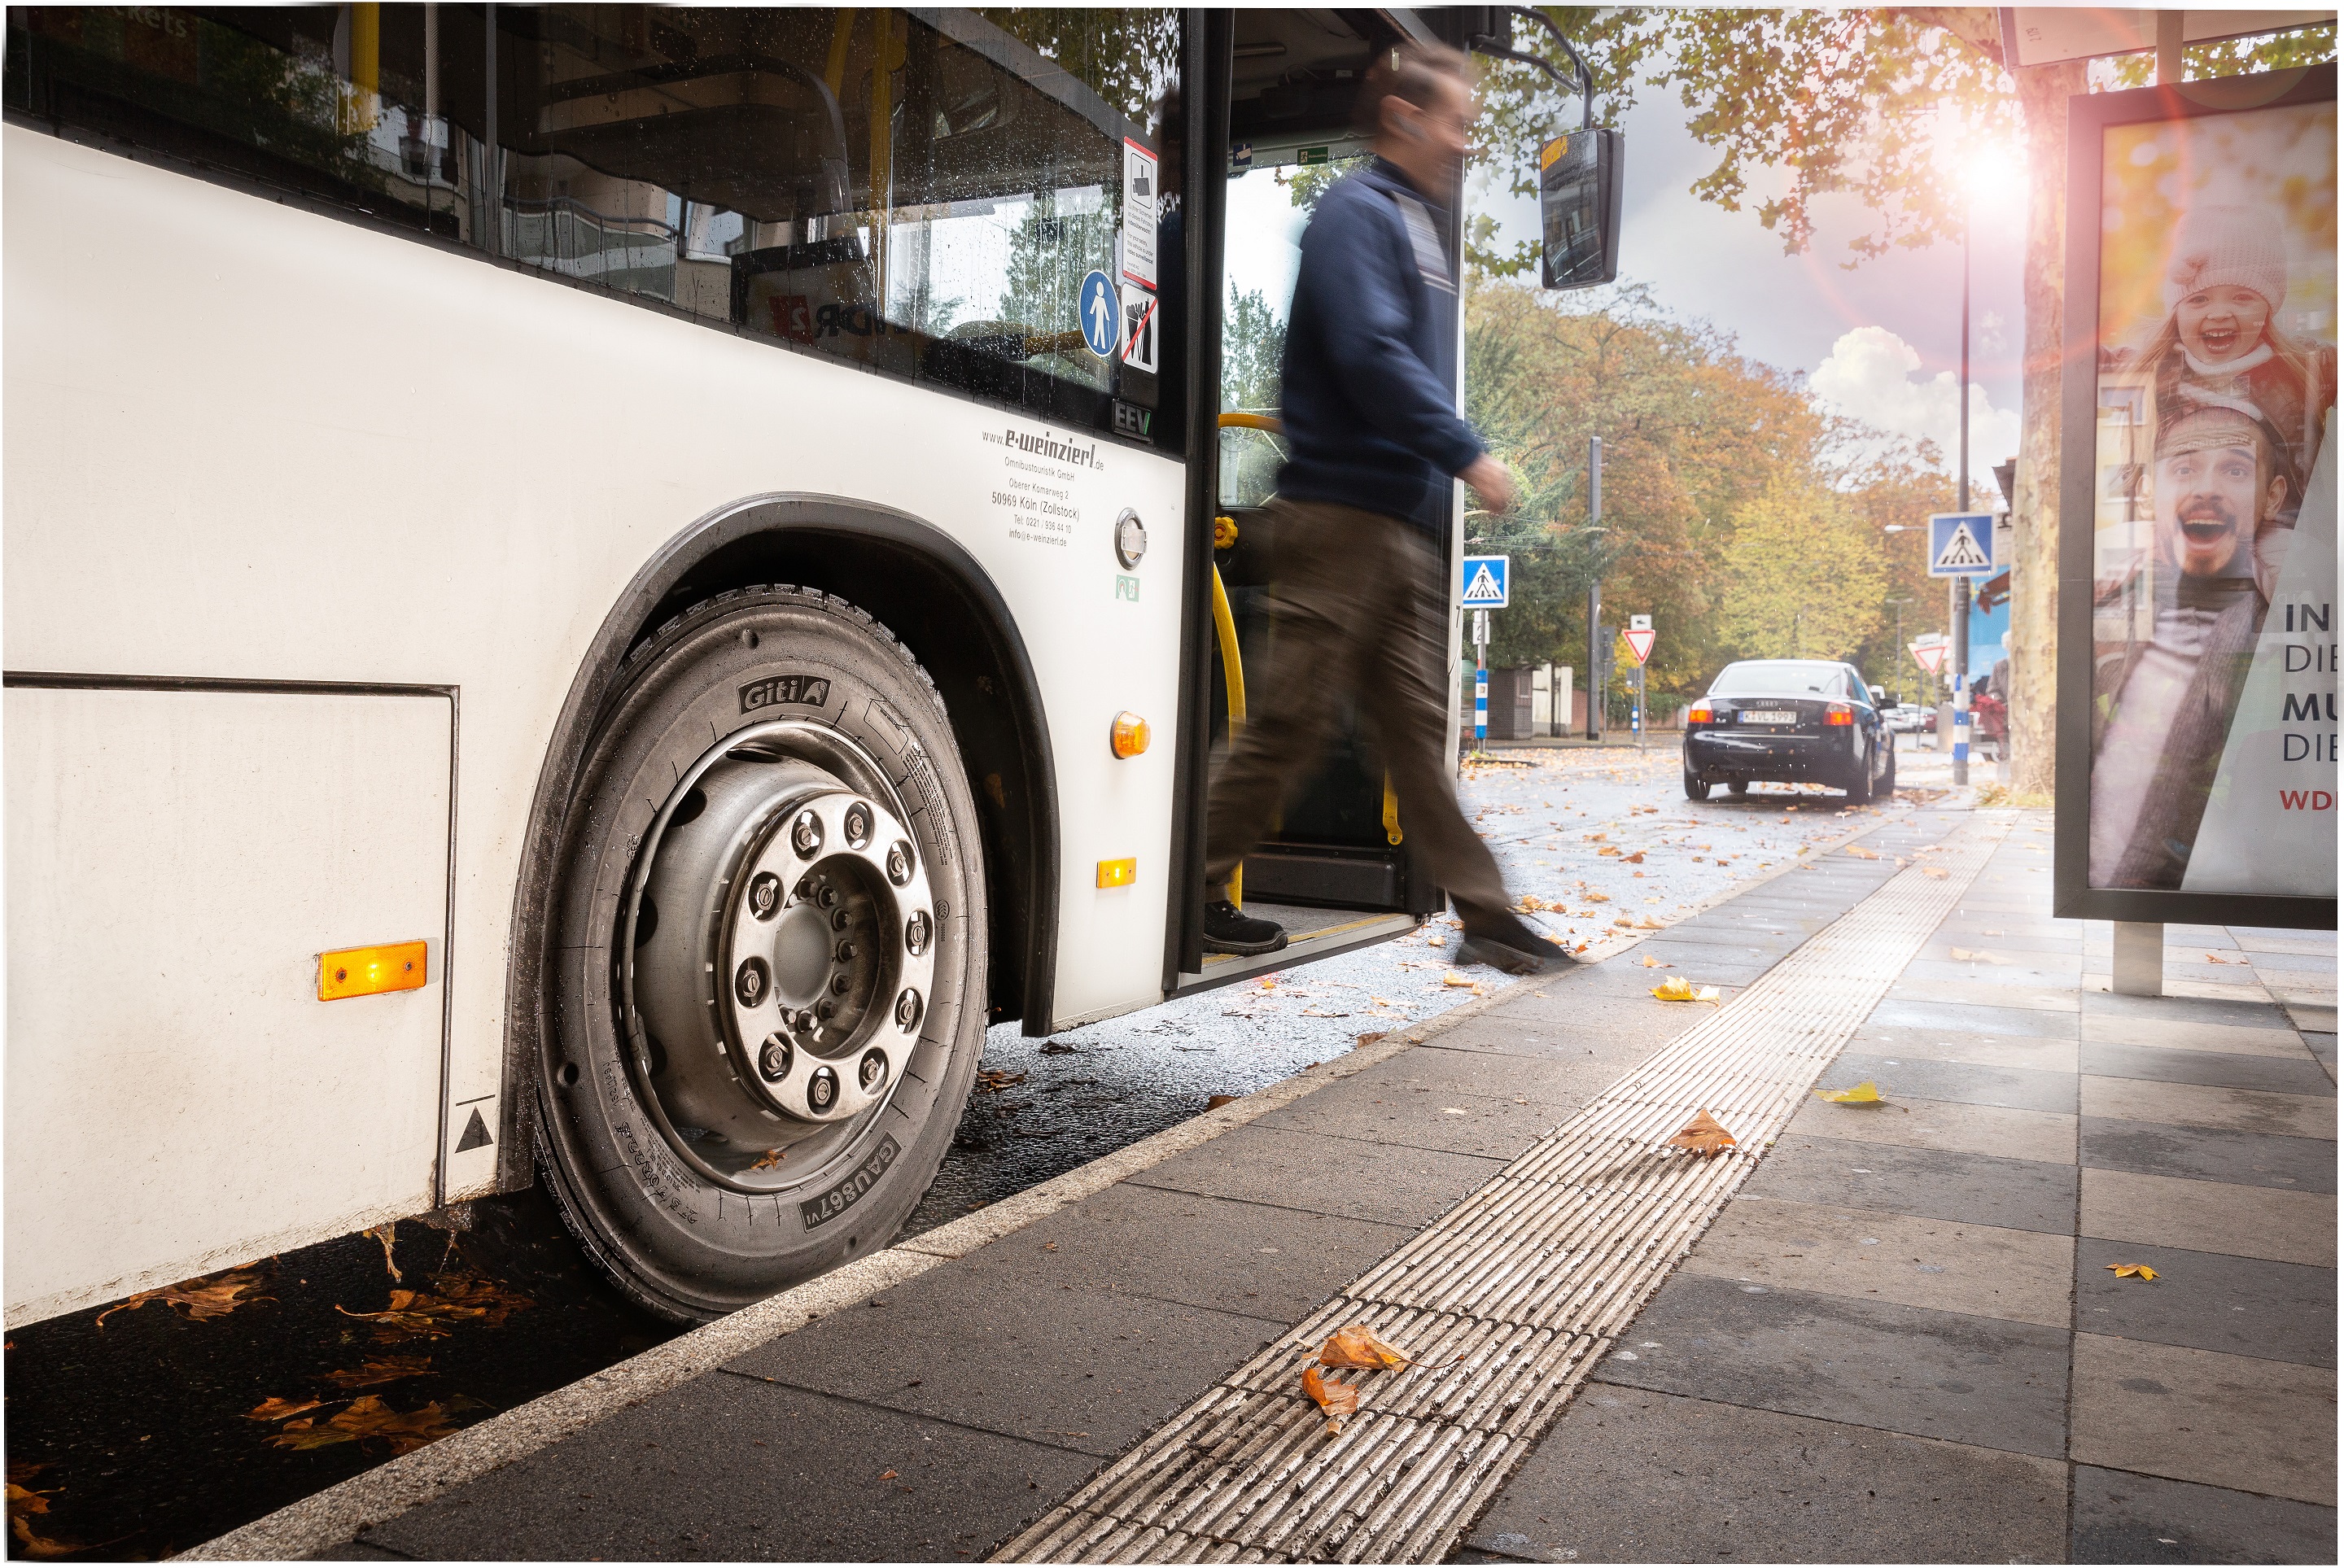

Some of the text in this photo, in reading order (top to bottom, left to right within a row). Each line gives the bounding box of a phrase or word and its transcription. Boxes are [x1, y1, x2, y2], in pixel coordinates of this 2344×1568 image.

[1116, 402, 1150, 435] EEV
[1004, 456, 1075, 482] Omnibustouristik GmbH
[1009, 477, 1030, 491] Oberer
[1065, 490, 1069, 500] 2
[991, 491, 1080, 523] 50969 Köln (Zollstock)
[1026, 517, 1039, 528] 0221
[1045, 520, 1056, 531] 936
[1056, 522, 1064, 532] 44
[1065, 524, 1072, 534] 10
[2279, 789, 2337, 811] WD
